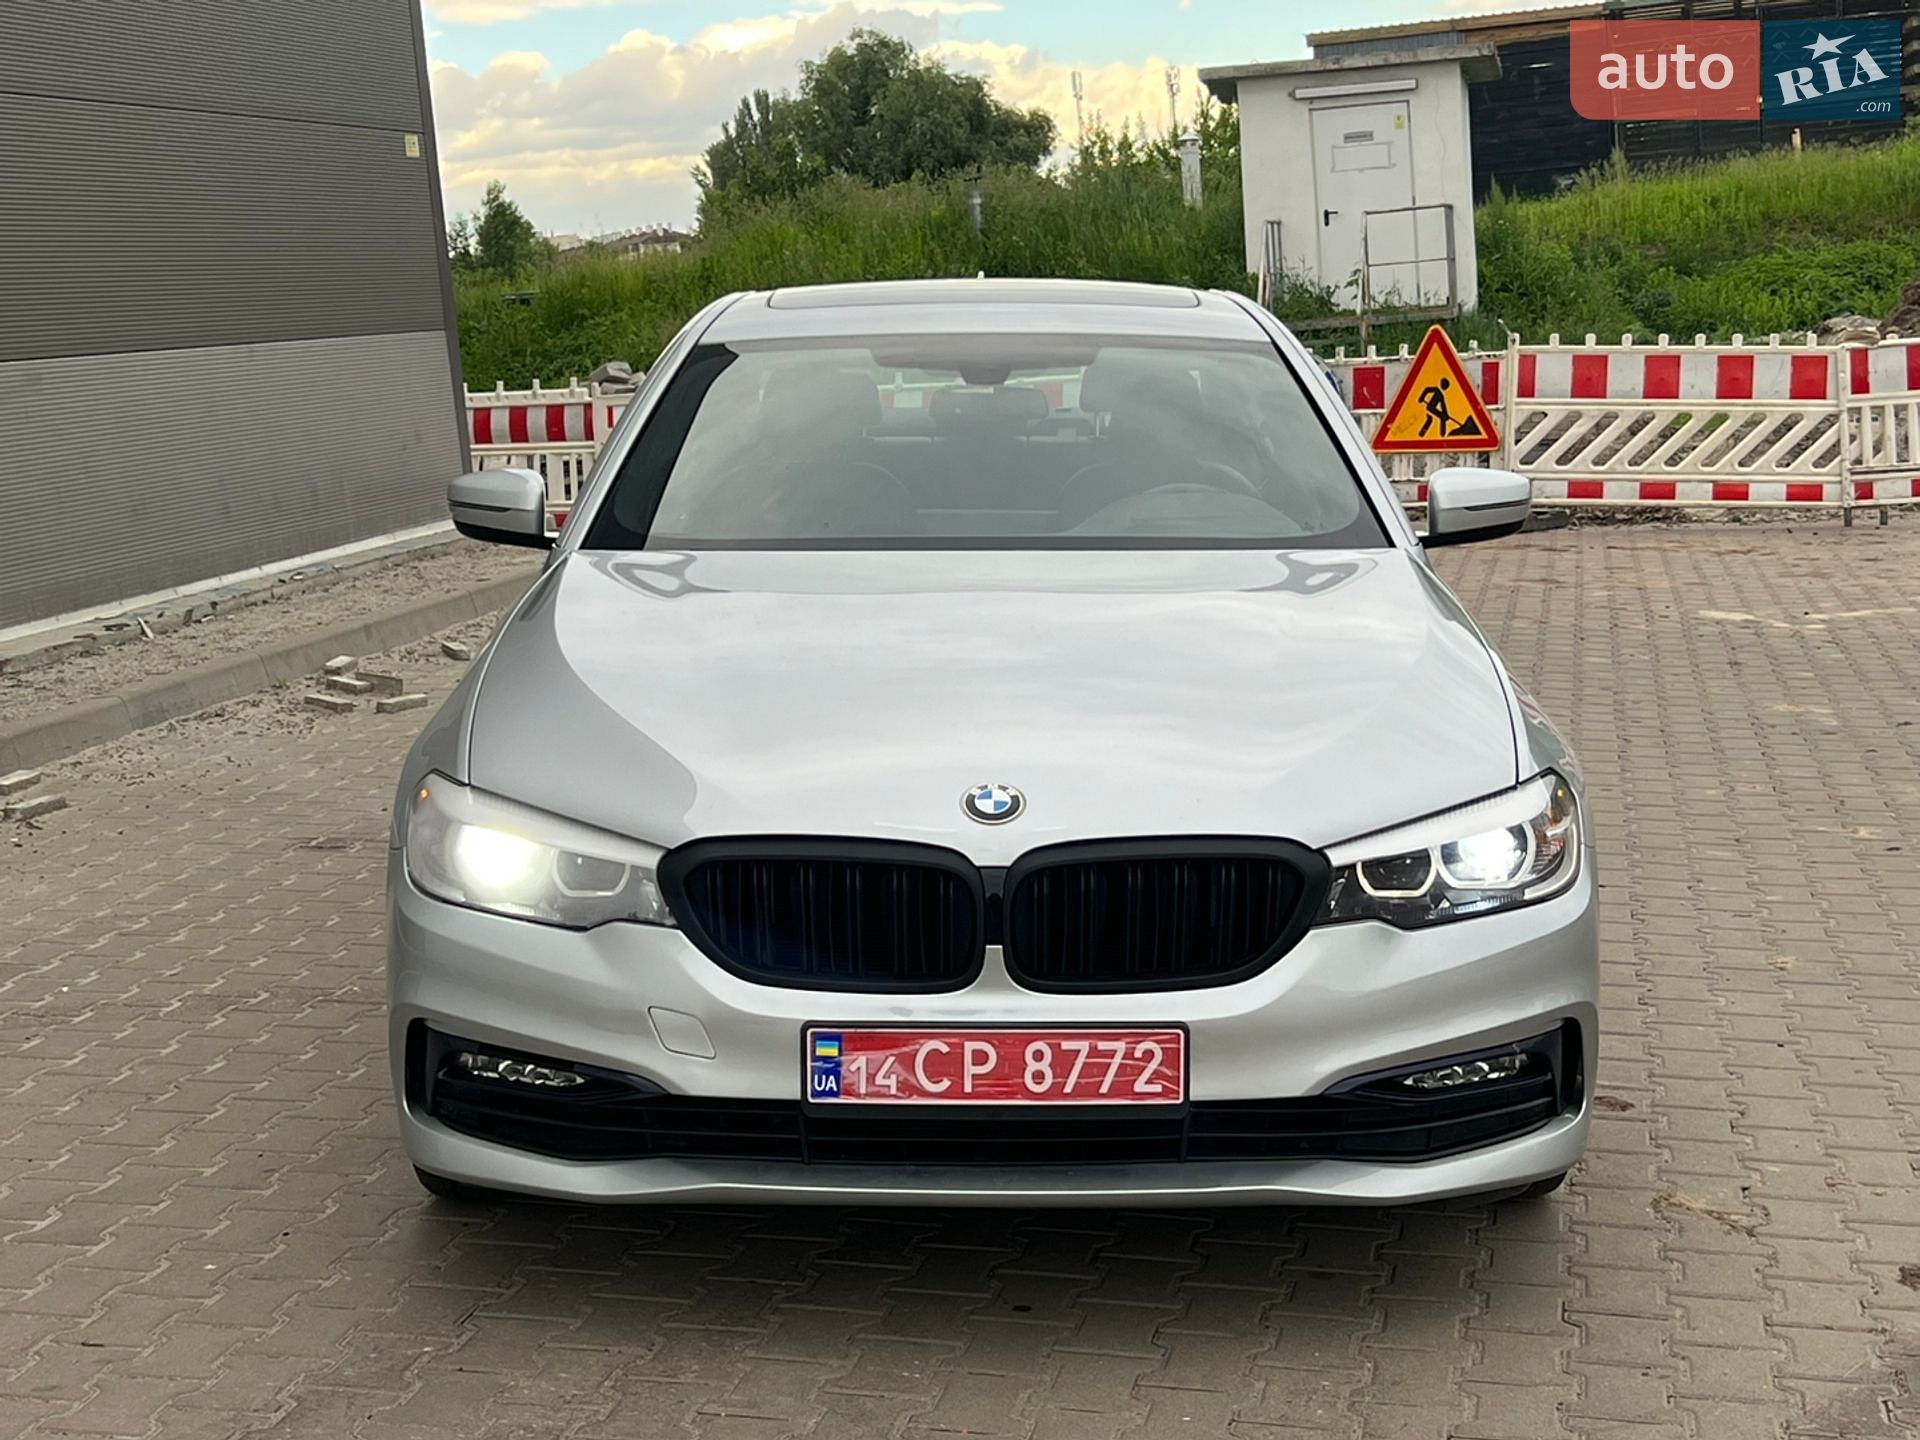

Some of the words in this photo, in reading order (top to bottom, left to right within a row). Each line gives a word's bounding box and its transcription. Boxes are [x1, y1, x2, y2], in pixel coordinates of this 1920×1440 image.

[813, 1074, 838, 1092] UA
[848, 1055, 898, 1095] 14
[914, 1039, 998, 1094] CP
[1024, 1040, 1164, 1095] 8772
